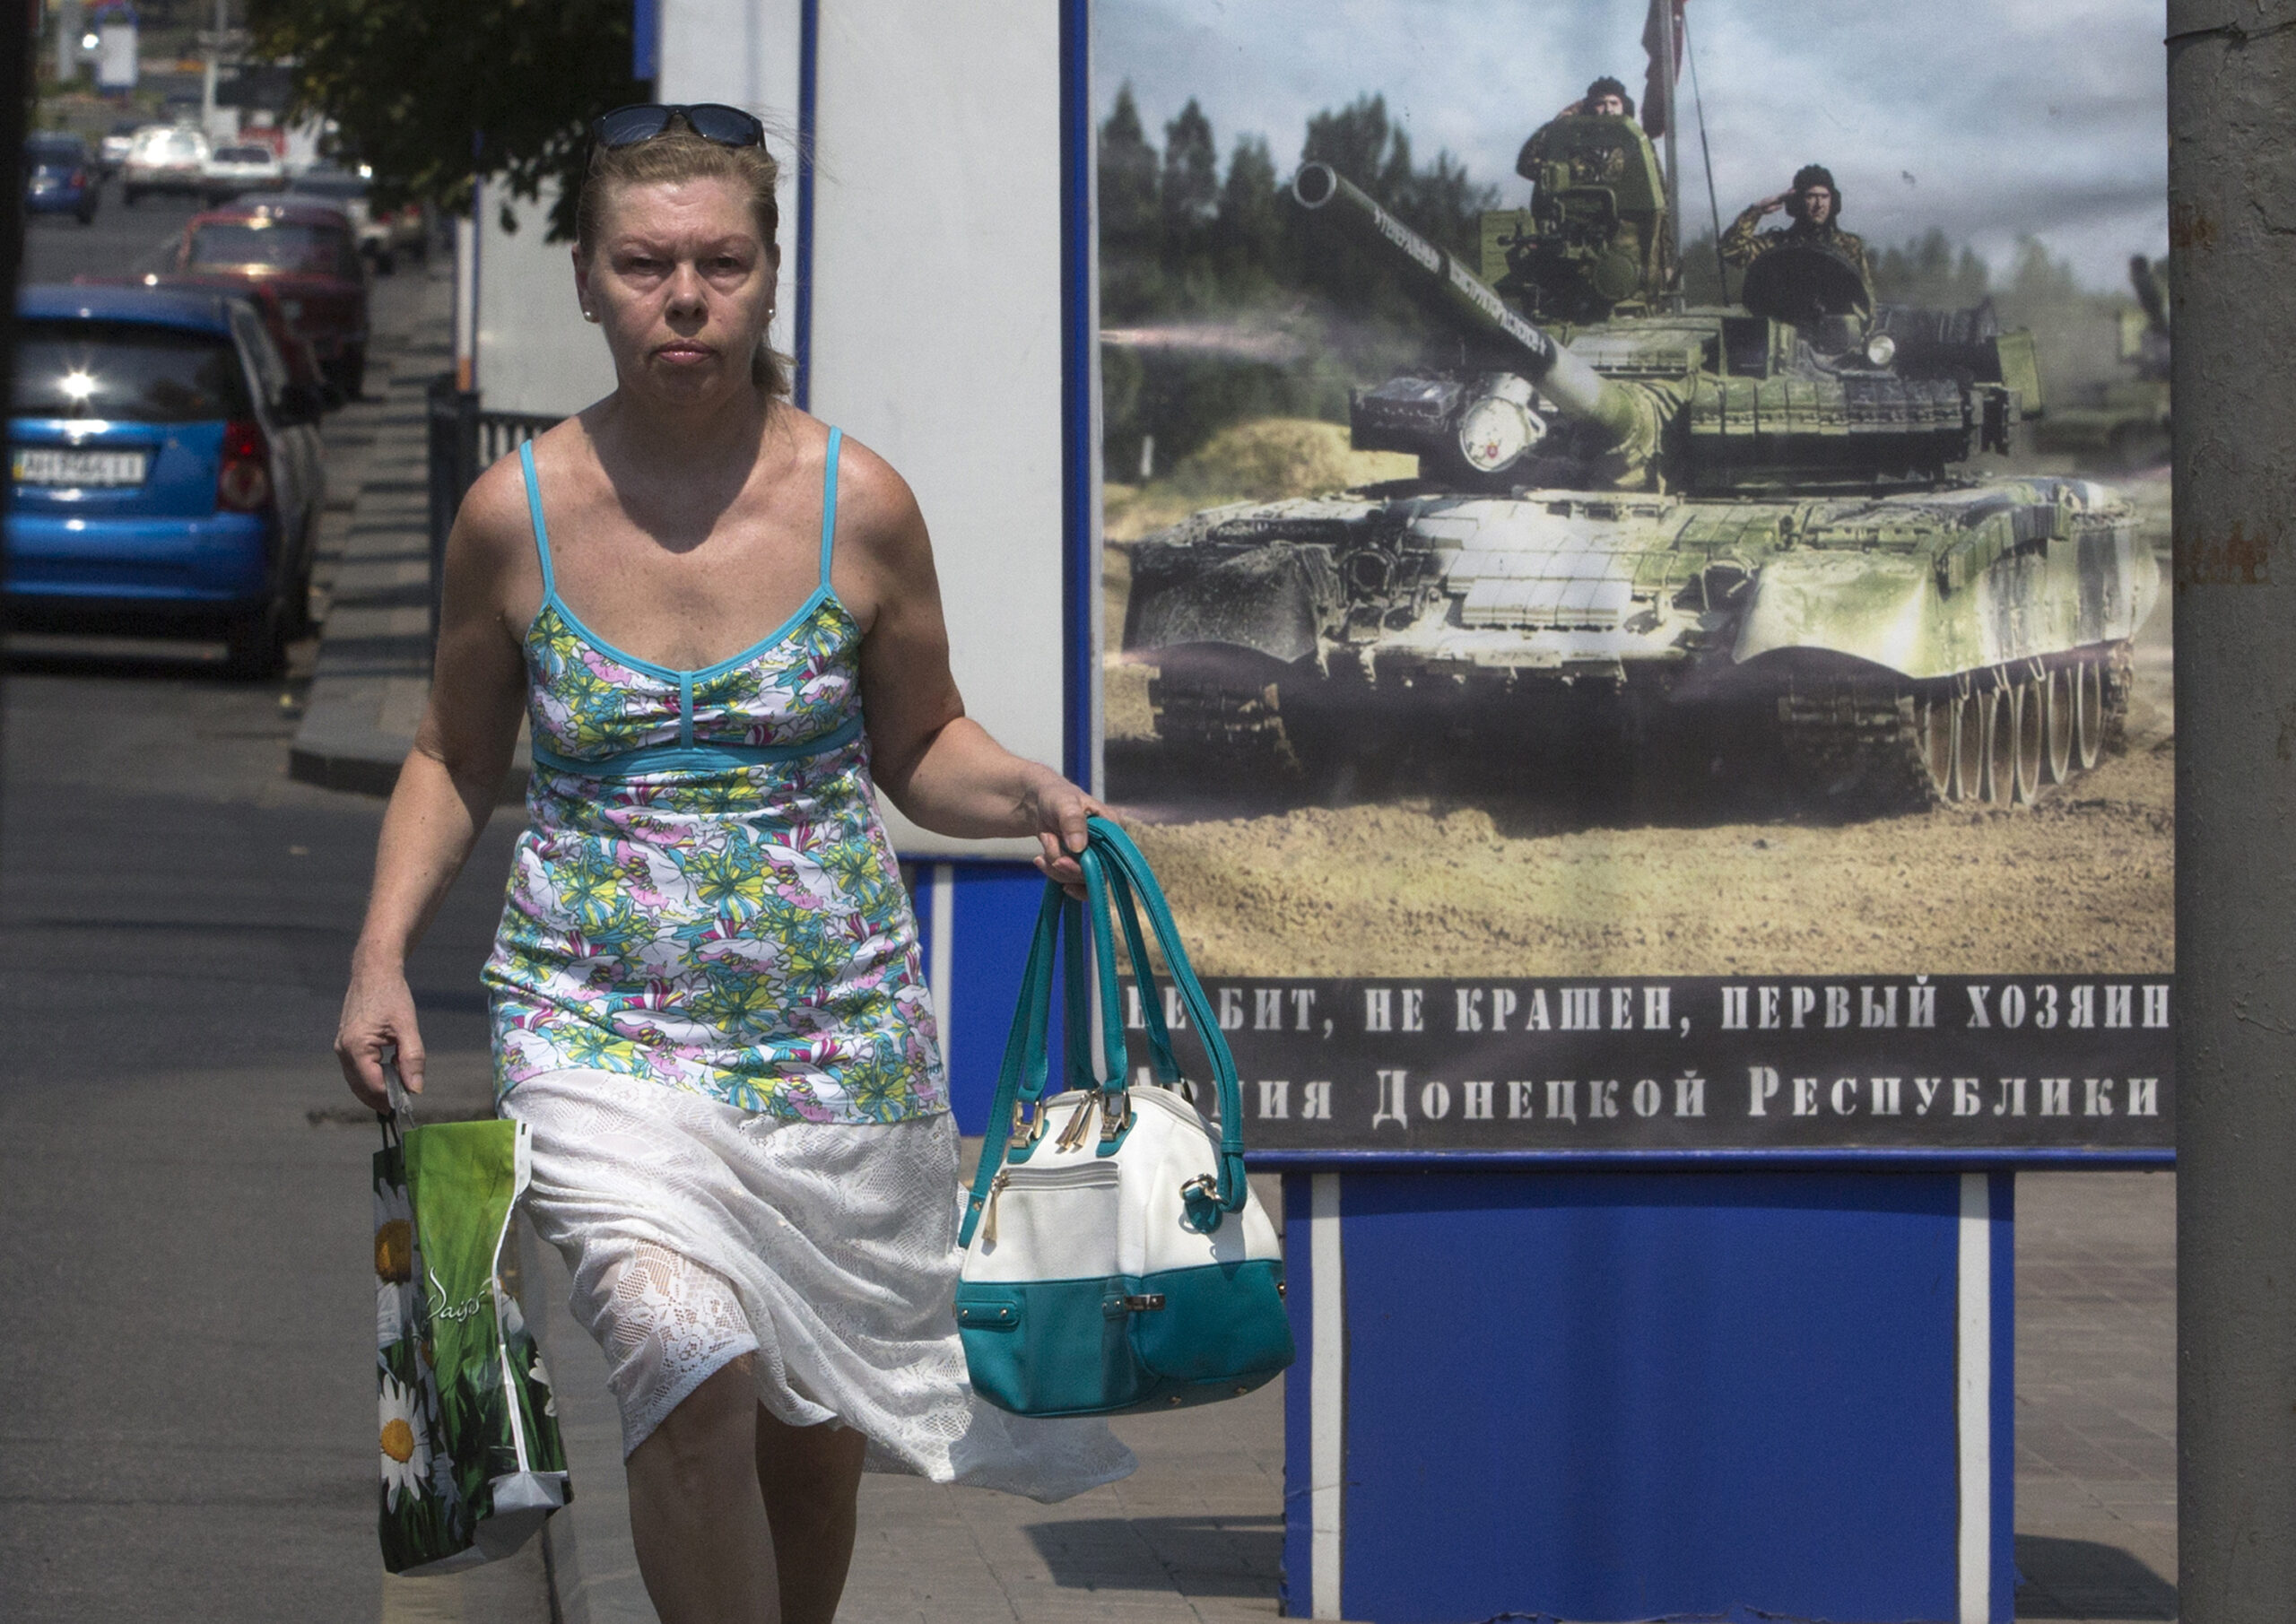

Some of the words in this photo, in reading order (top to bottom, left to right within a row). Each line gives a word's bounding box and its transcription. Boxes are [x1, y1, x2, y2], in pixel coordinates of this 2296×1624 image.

[1218, 987, 1334, 1039] БИТ,
[1364, 987, 1424, 1031] НЕ
[1455, 986, 1691, 1038] КРАШЕН,
[1721, 974, 1937, 1030] ПЕРВЫЙ
[1967, 984, 2170, 1029] ХОЗЯИН
